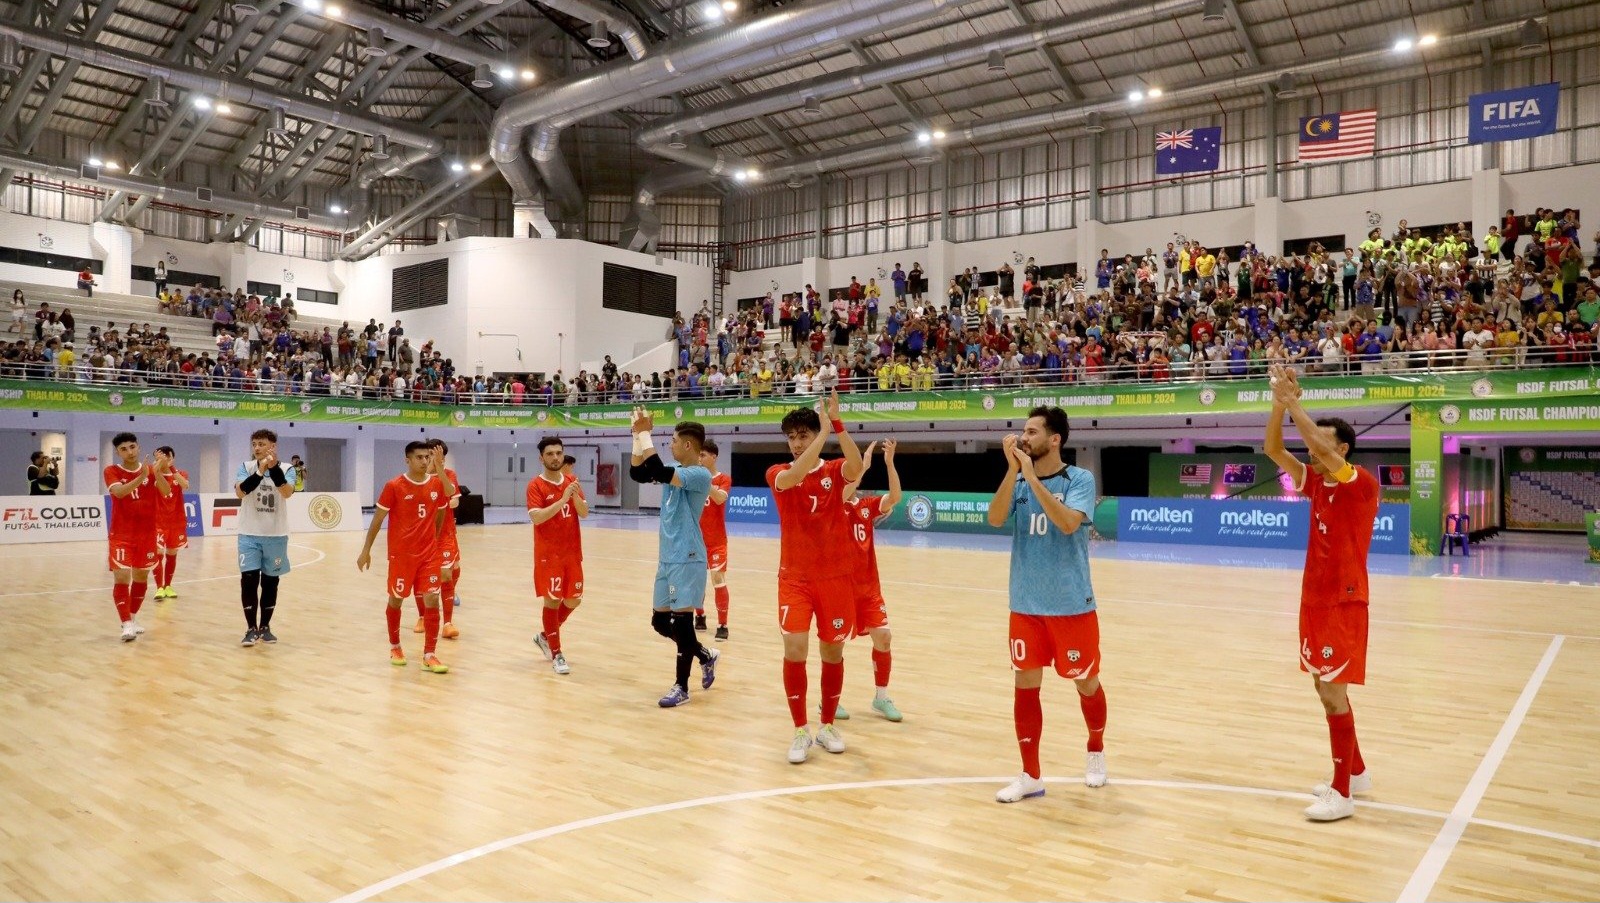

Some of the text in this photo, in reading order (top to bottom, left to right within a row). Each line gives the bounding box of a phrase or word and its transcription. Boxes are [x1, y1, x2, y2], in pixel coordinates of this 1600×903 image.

[1483, 99, 1540, 121] FIFA
[1238, 391, 1259, 402] NSDF
[1299, 387, 1365, 400] HAMPIONSHIP
[1368, 387, 1415, 399] THAILAND
[1418, 384, 1445, 397] 2024
[1517, 382, 1545, 394] NSDF
[1550, 379, 1590, 392] FUTSAL
[26, 390, 65, 401] THAILAND
[67, 392, 88, 402] 2024
[141, 396, 160, 406] NSDF
[162, 398, 187, 408] FUTSAL
[188, 399, 237, 410] CHAMPIONSHIP
[239, 402, 268, 411] THAILAND
[1013, 393, 1175, 408] NSDF FUTSAL CHAMPIONSHIP THAILAND 2024
[724, 406, 760, 416] CHAMPIONSHIP
[761, 405, 785, 415] THAILAND
[852, 403, 872, 412] FUTSAL
[873, 401, 918, 411] CHAMPIONSHIP
[918, 400, 948, 410] THAILAND
[949, 399, 967, 410] 2024
[1469, 408, 1497, 421] NSDF
[1500, 408, 1540, 421] FUTSAL
[729, 494, 767, 507] molten
[809, 495, 818, 513] 7
[936, 500, 952, 511] NSDF
[953, 501, 975, 512] FUTSAL
[418, 503, 427, 518] 5
[561, 503, 572, 519] 12
[936, 511, 966, 523] THAILAND
[966, 512, 984, 523] 2024
[1131, 506, 1193, 523] molten
[1220, 509, 1288, 527] molten
[5, 520, 101, 531] FUTSAL THAILEAGUE
[1029, 513, 1048, 535] 10
[1128, 523, 1192, 535] For the real game
[854, 523, 867, 542] 16
[1218, 526, 1288, 539] For the real game
[115, 548, 125, 561] 11
[396, 578, 405, 593] 5
[550, 576, 562, 592] 12
[780, 605, 789, 626] 7
[1010, 638, 1026, 661] 10
[1302, 637, 1312, 660] 4
